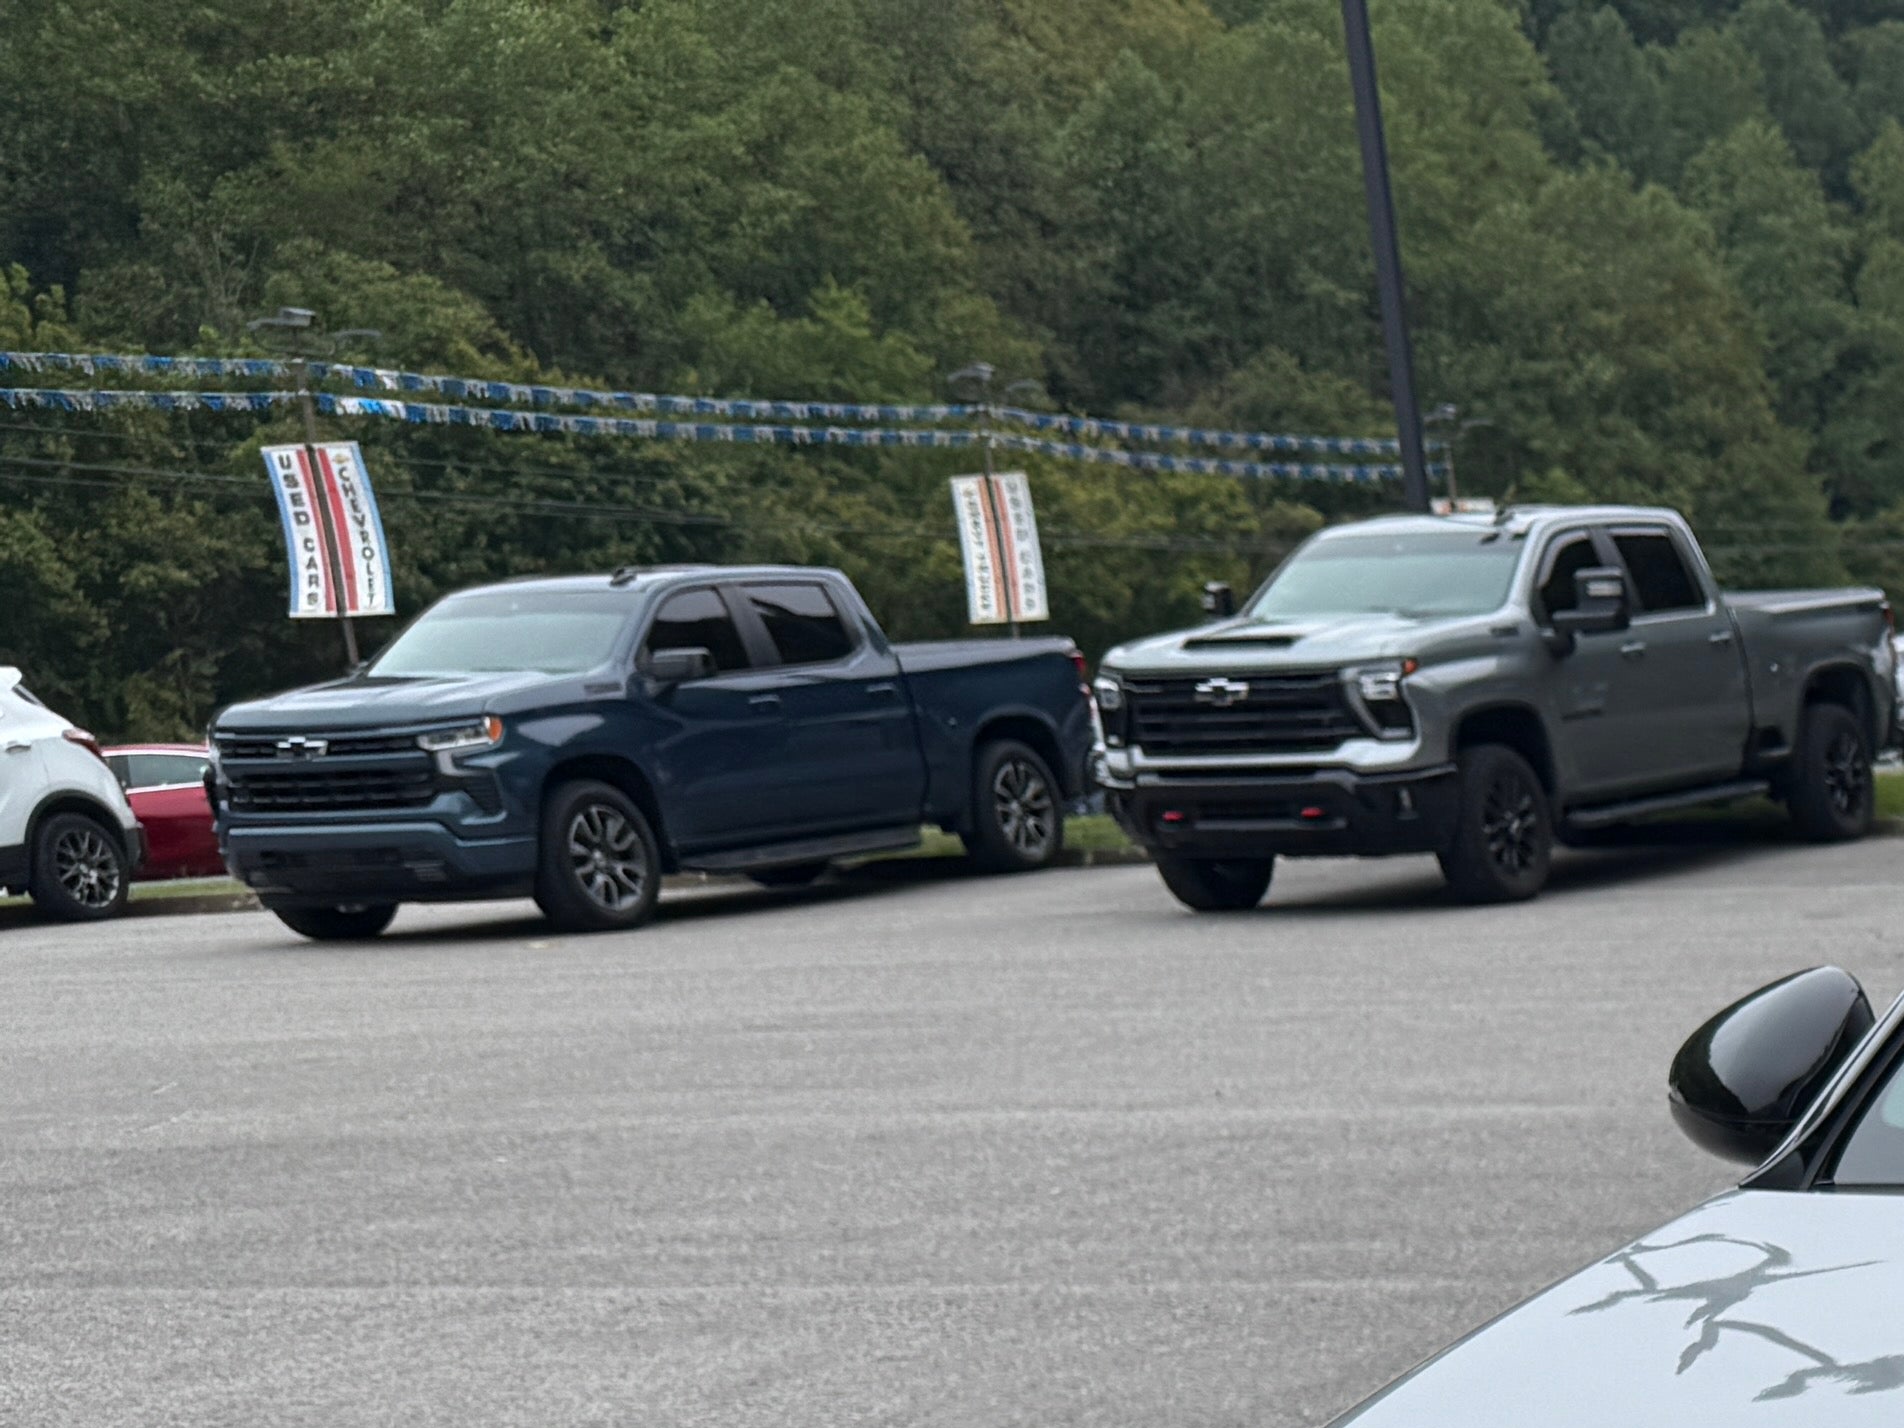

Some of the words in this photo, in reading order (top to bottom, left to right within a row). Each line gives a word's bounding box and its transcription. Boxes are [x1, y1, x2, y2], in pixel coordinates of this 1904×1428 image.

[278, 454, 310, 526] USED
[303, 538, 319, 606] CARS
[338, 466, 375, 608] CHEVROLET
